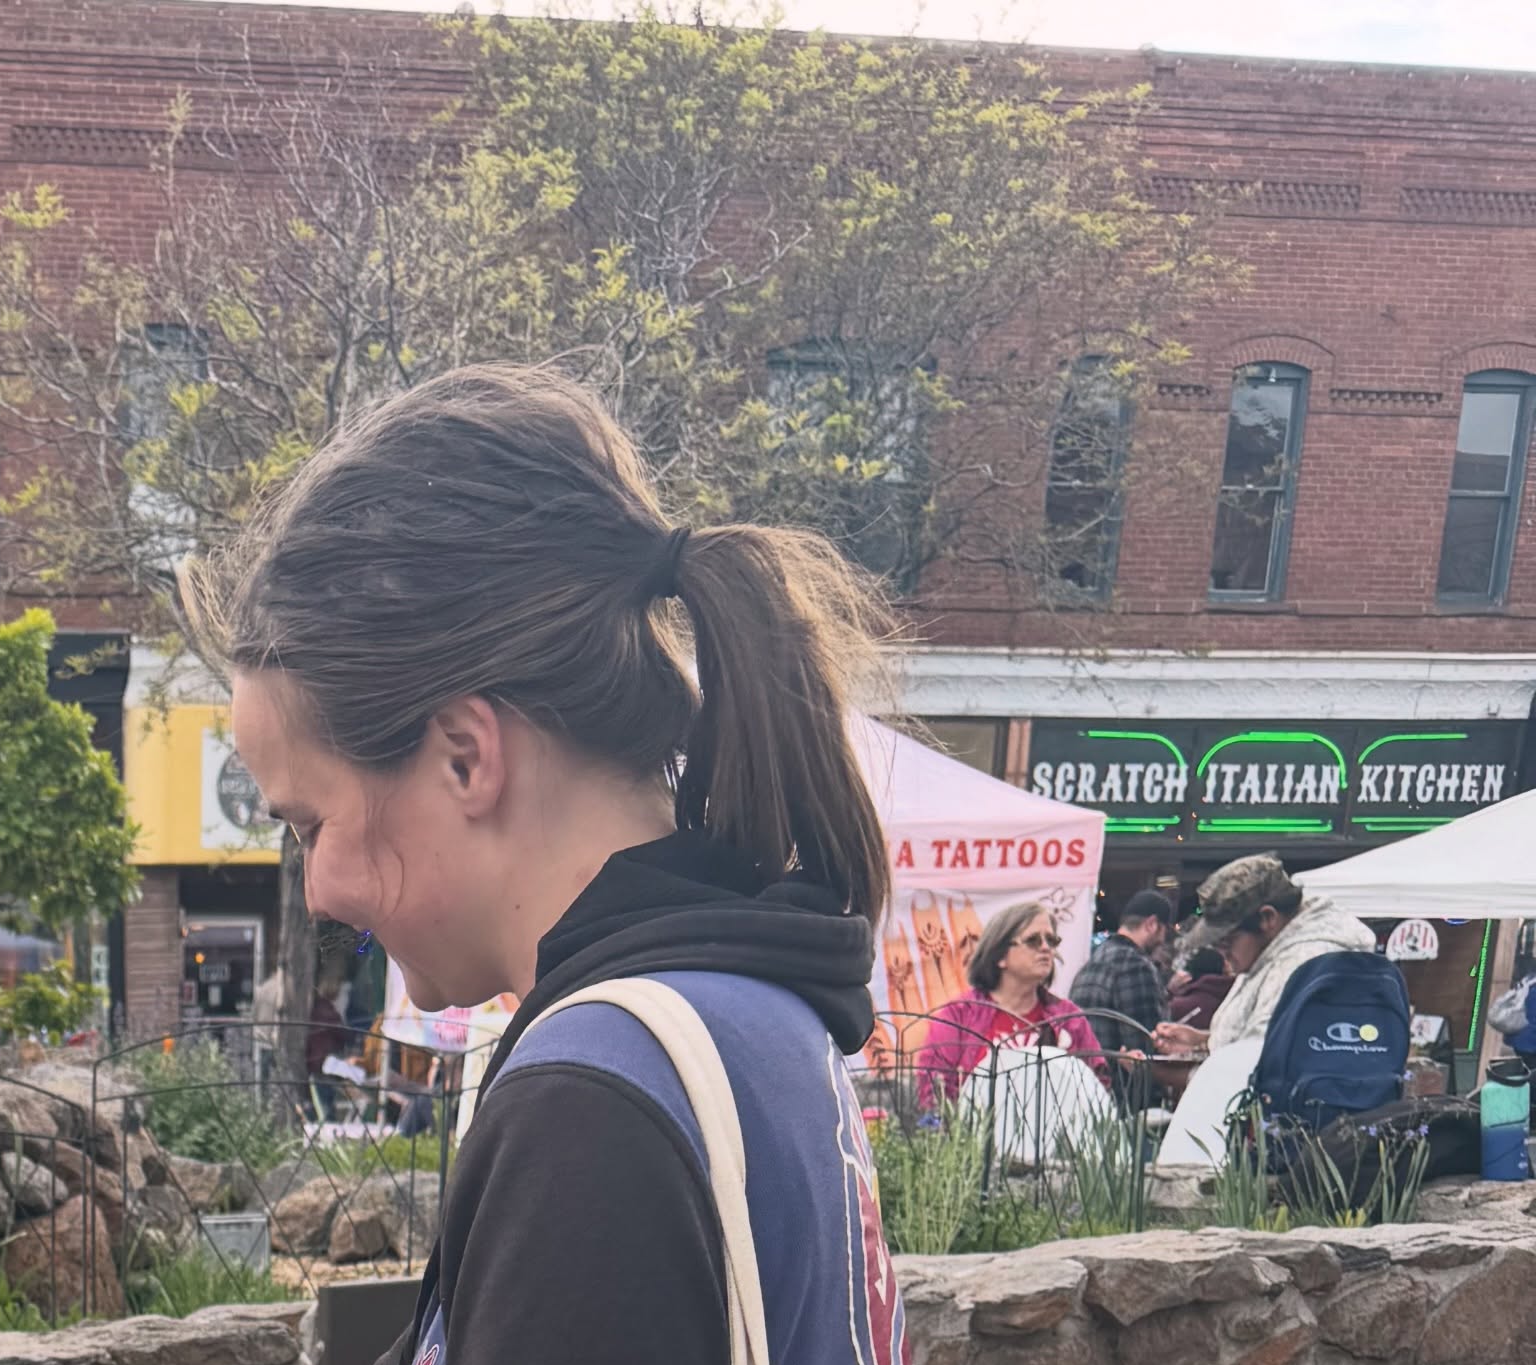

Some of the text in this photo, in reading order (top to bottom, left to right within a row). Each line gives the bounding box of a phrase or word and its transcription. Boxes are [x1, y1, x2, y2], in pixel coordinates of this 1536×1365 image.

[1030, 761, 1507, 805] SCRATCH ITALIAN KITCHEN
[933, 838, 1087, 869] TATTOOS
